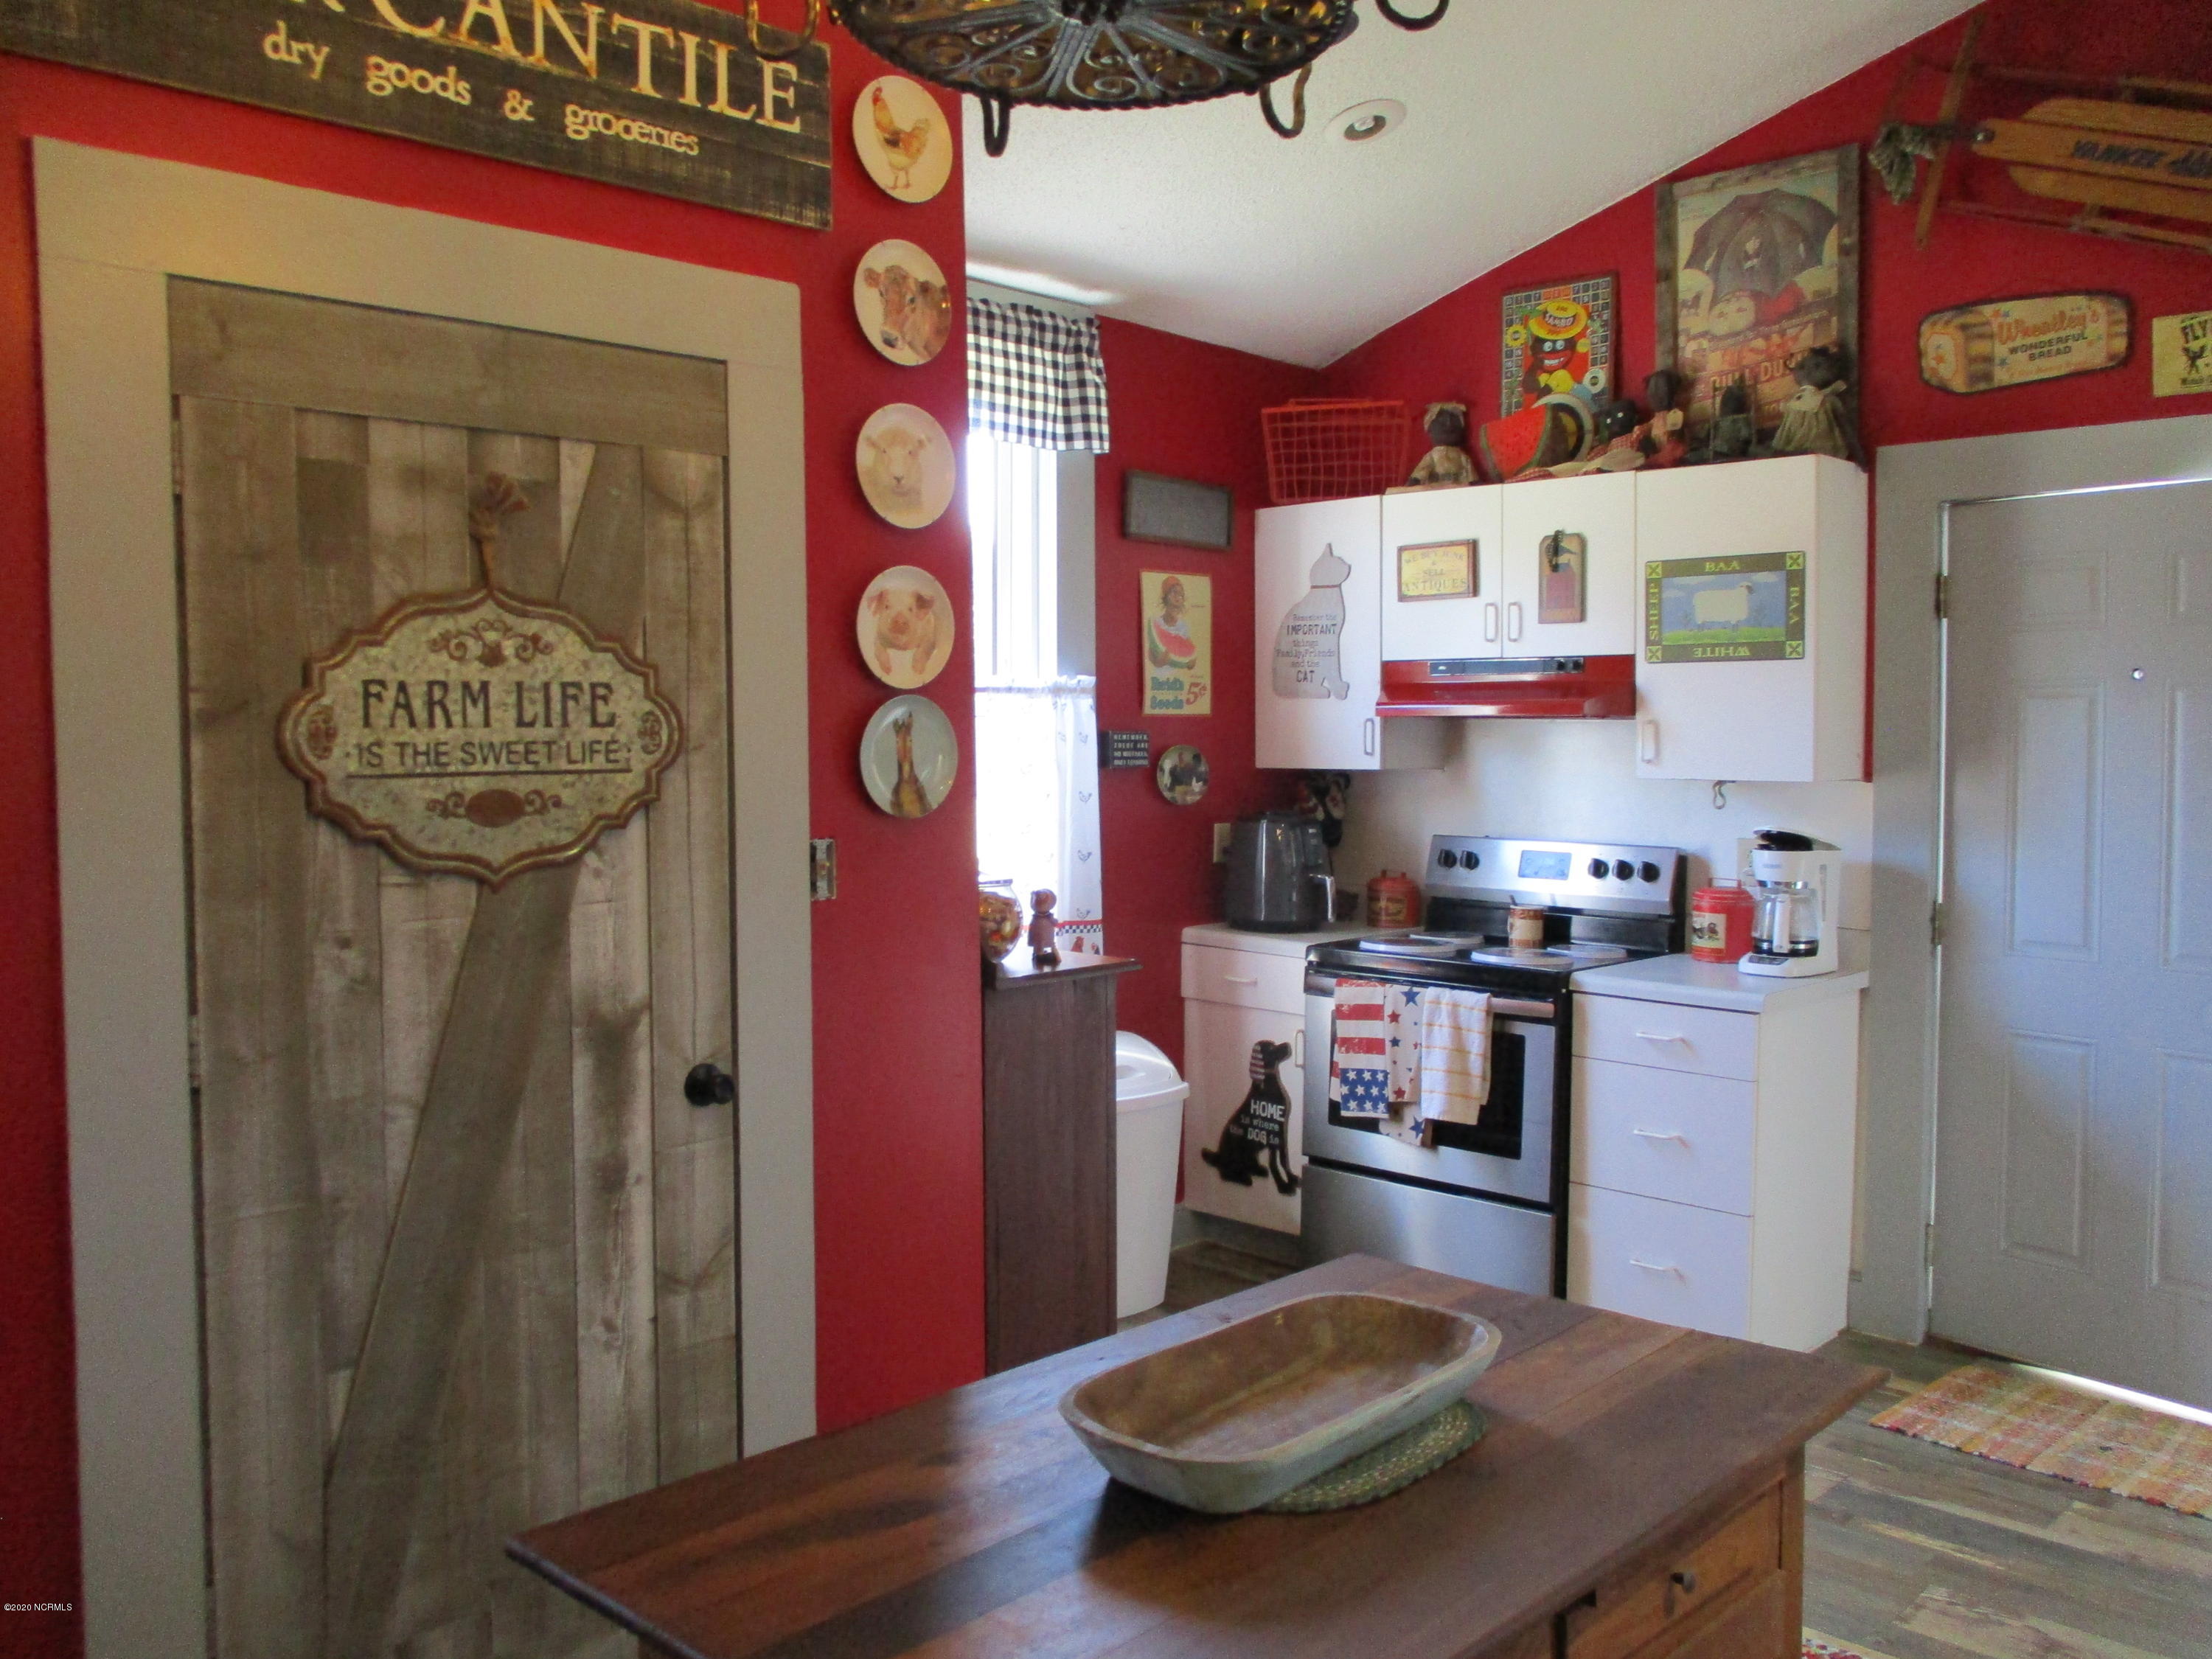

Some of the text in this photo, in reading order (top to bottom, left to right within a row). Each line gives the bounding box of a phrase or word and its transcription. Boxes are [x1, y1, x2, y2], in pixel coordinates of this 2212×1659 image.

[293, 0, 801, 133] CANTILE
[263, 19, 700, 156] dry goods & groceries
[2009, 331, 2088, 355] WONDERFUL
[2028, 345, 2072, 361] BREAD
[1705, 560, 1740, 572] BAA
[1287, 624, 1338, 635] IMPORTANT
[1693, 646, 1750, 658] WHITE
[1296, 669, 1315, 683] CAT
[361, 678, 617, 729] FARM LIFE
[357, 738, 621, 768] IS THE SWEET LIFE
[1250, 1099, 1285, 1122] HOME
[1253, 1118, 1280, 1132] where
[1248, 1127, 1267, 1145] DOG
